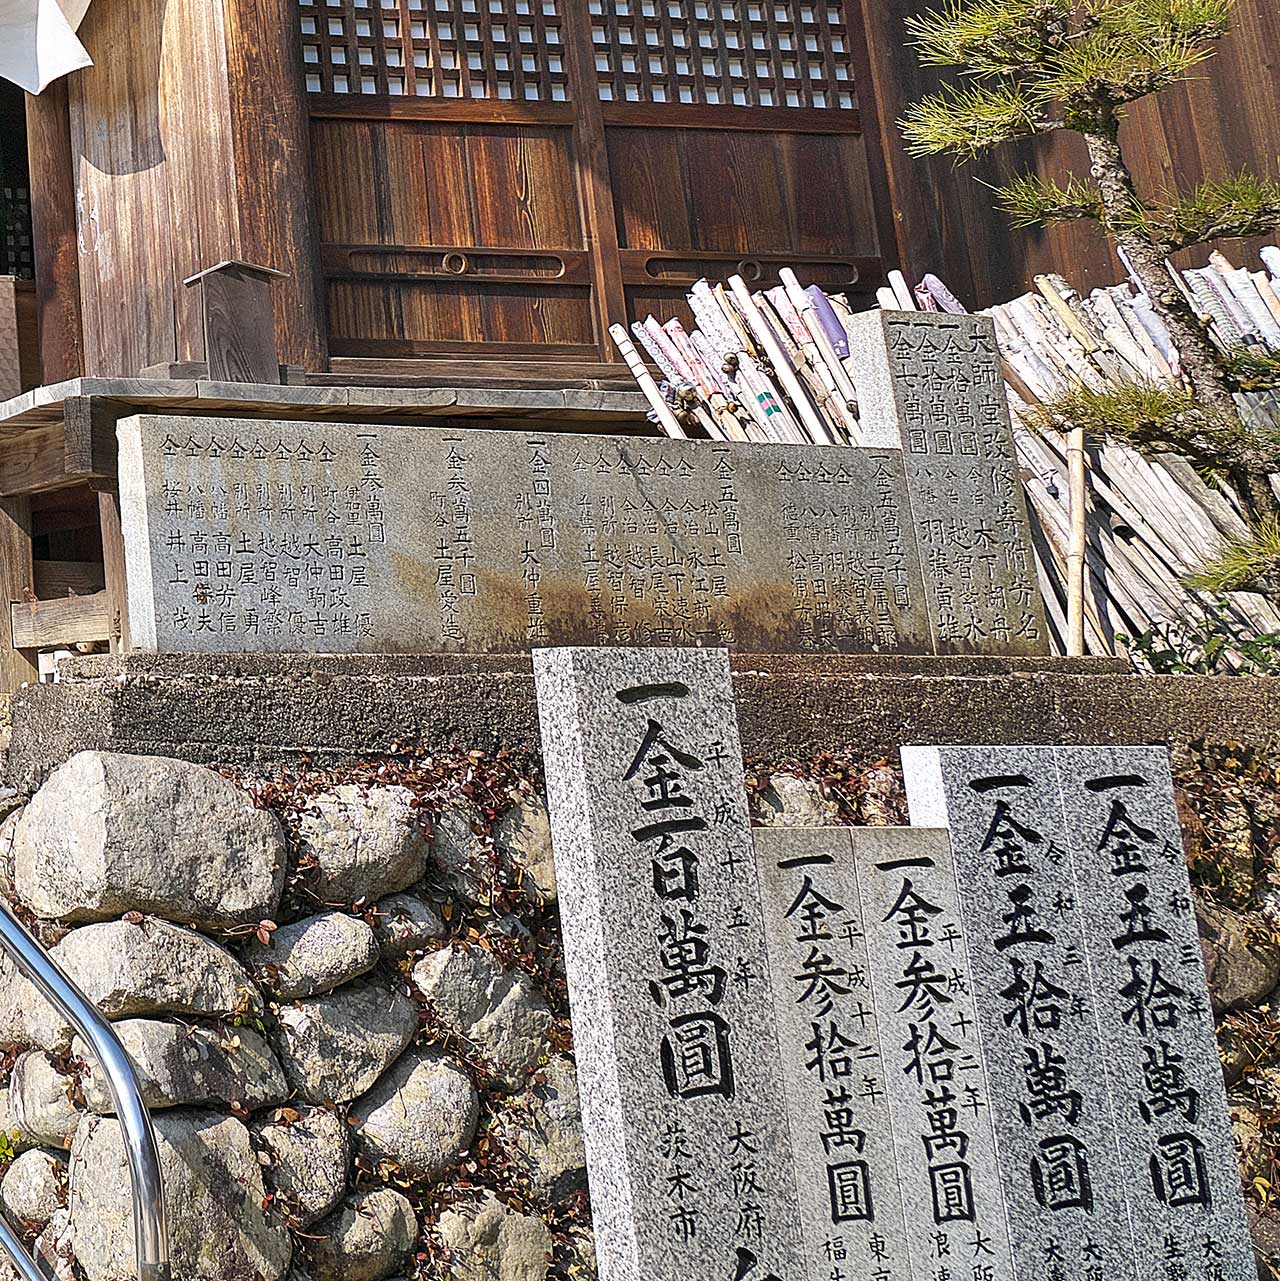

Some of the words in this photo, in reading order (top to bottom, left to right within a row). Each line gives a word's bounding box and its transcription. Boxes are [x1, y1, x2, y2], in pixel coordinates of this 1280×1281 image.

[615, 680, 736, 1104] 一金百萬圓
[705, 741, 753, 990] 平成十五年
[1044, 841, 1090, 1020] 令和三年
[1159, 842, 1206, 1020] 令和三年
[837, 920, 883, 1105] 平成十二年
[938, 923, 986, 1117] 平成十二年
[968, 773, 1094, 1215] 一金五拾萬圓
[1084, 773, 1213, 1215] 一金五拾萬圓
[657, 1124, 700, 1243] 茨木市
[728, 1120, 766, 1239] 大阪府
